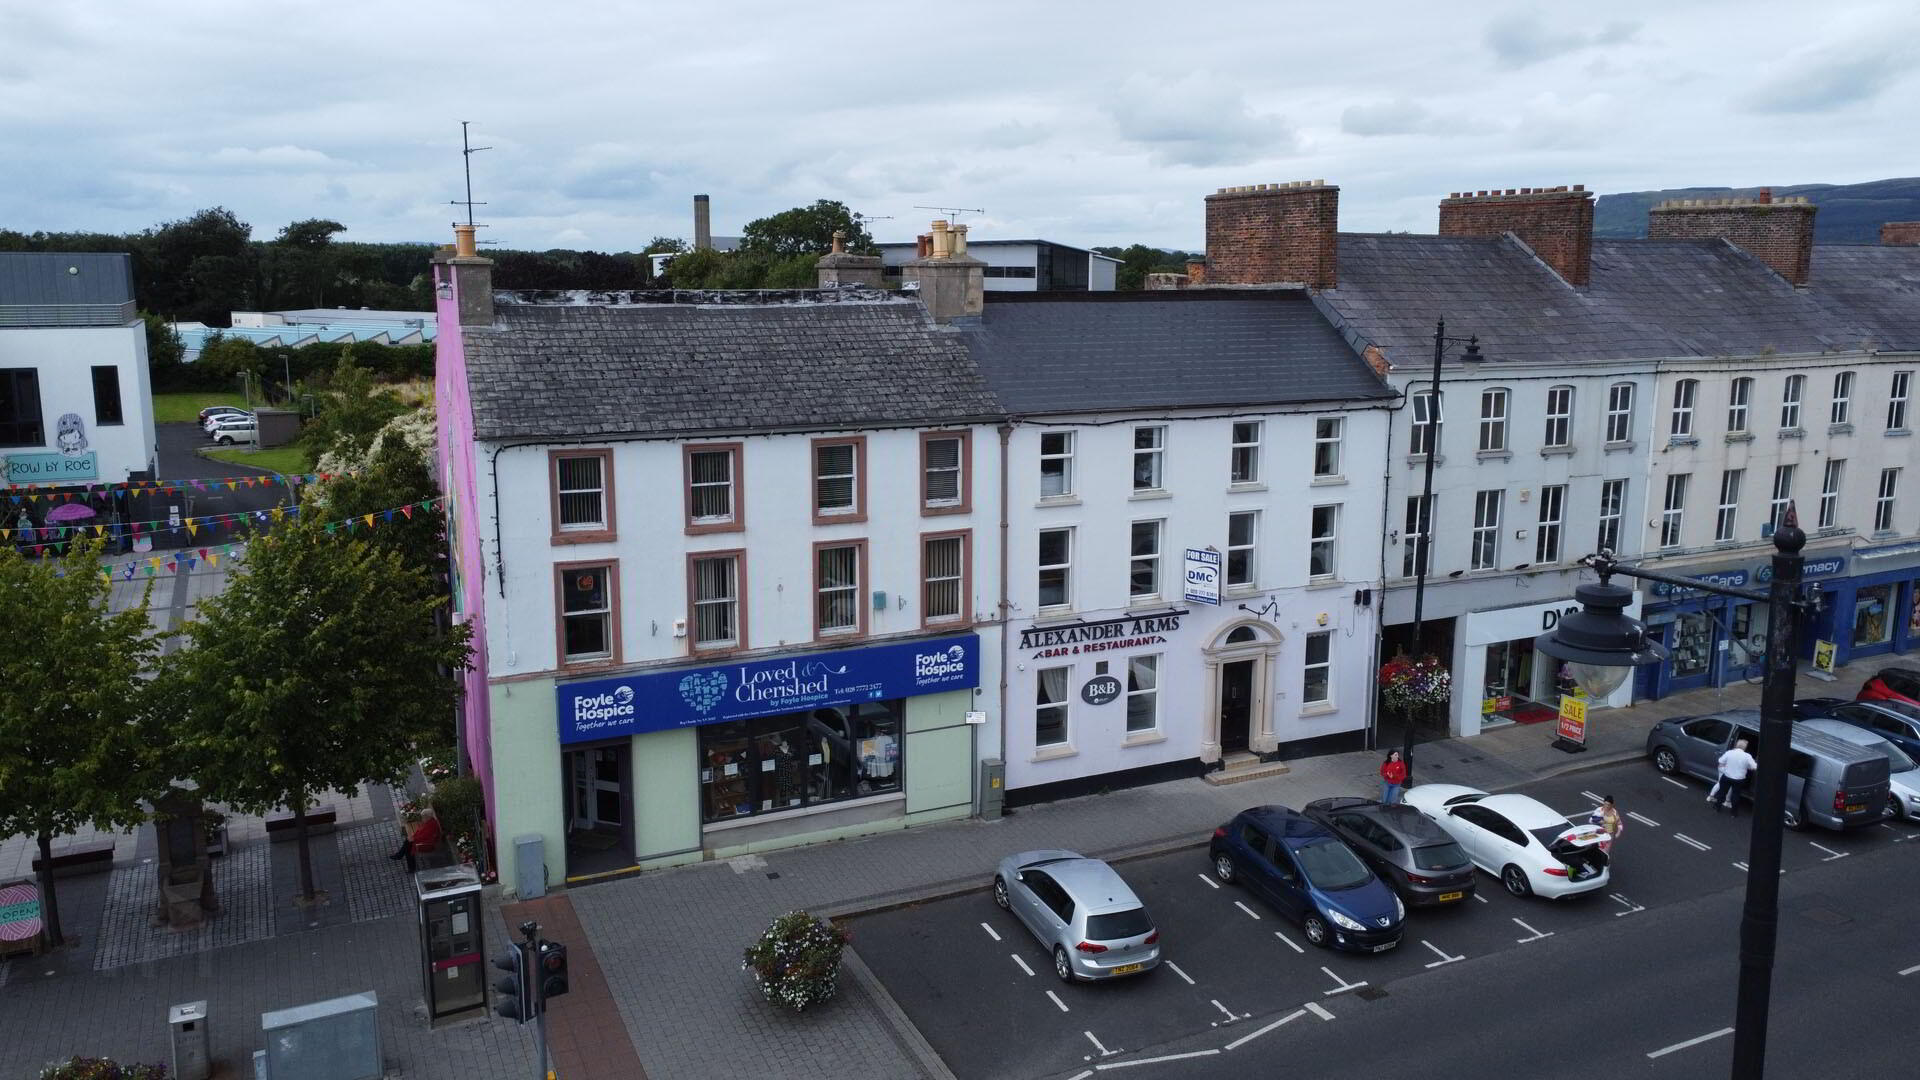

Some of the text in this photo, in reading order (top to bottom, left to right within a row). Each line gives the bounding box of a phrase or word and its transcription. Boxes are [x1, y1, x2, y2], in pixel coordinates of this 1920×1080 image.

[12, 462, 40, 474] ROW
[1187, 550, 1218, 563] FOR SALE
[1188, 570, 1213, 583] DMC
[1019, 617, 1180, 649] ALEXANDER ARMS
[1044, 636, 1156, 658] BAR & RESTAURANT
[915, 651, 948, 667] Foyle
[739, 660, 797, 685] Loved
[915, 661, 964, 677] Hospice
[735, 673, 828, 703] Cherished
[915, 675, 941, 686] Together
[1089, 681, 1116, 697] B&B
[574, 693, 614, 709] Foyle
[770, 699, 779, 707] by
[780, 696, 800, 706] Foyle
[800, 693, 829, 703] Hospice
[575, 704, 634, 721] Hospice
[1563, 703, 1583, 719] SALE
[575, 717, 635, 732] Together we care
[1568, 724, 1582, 735] PRICE
[2, 907, 34, 920] OPEN
